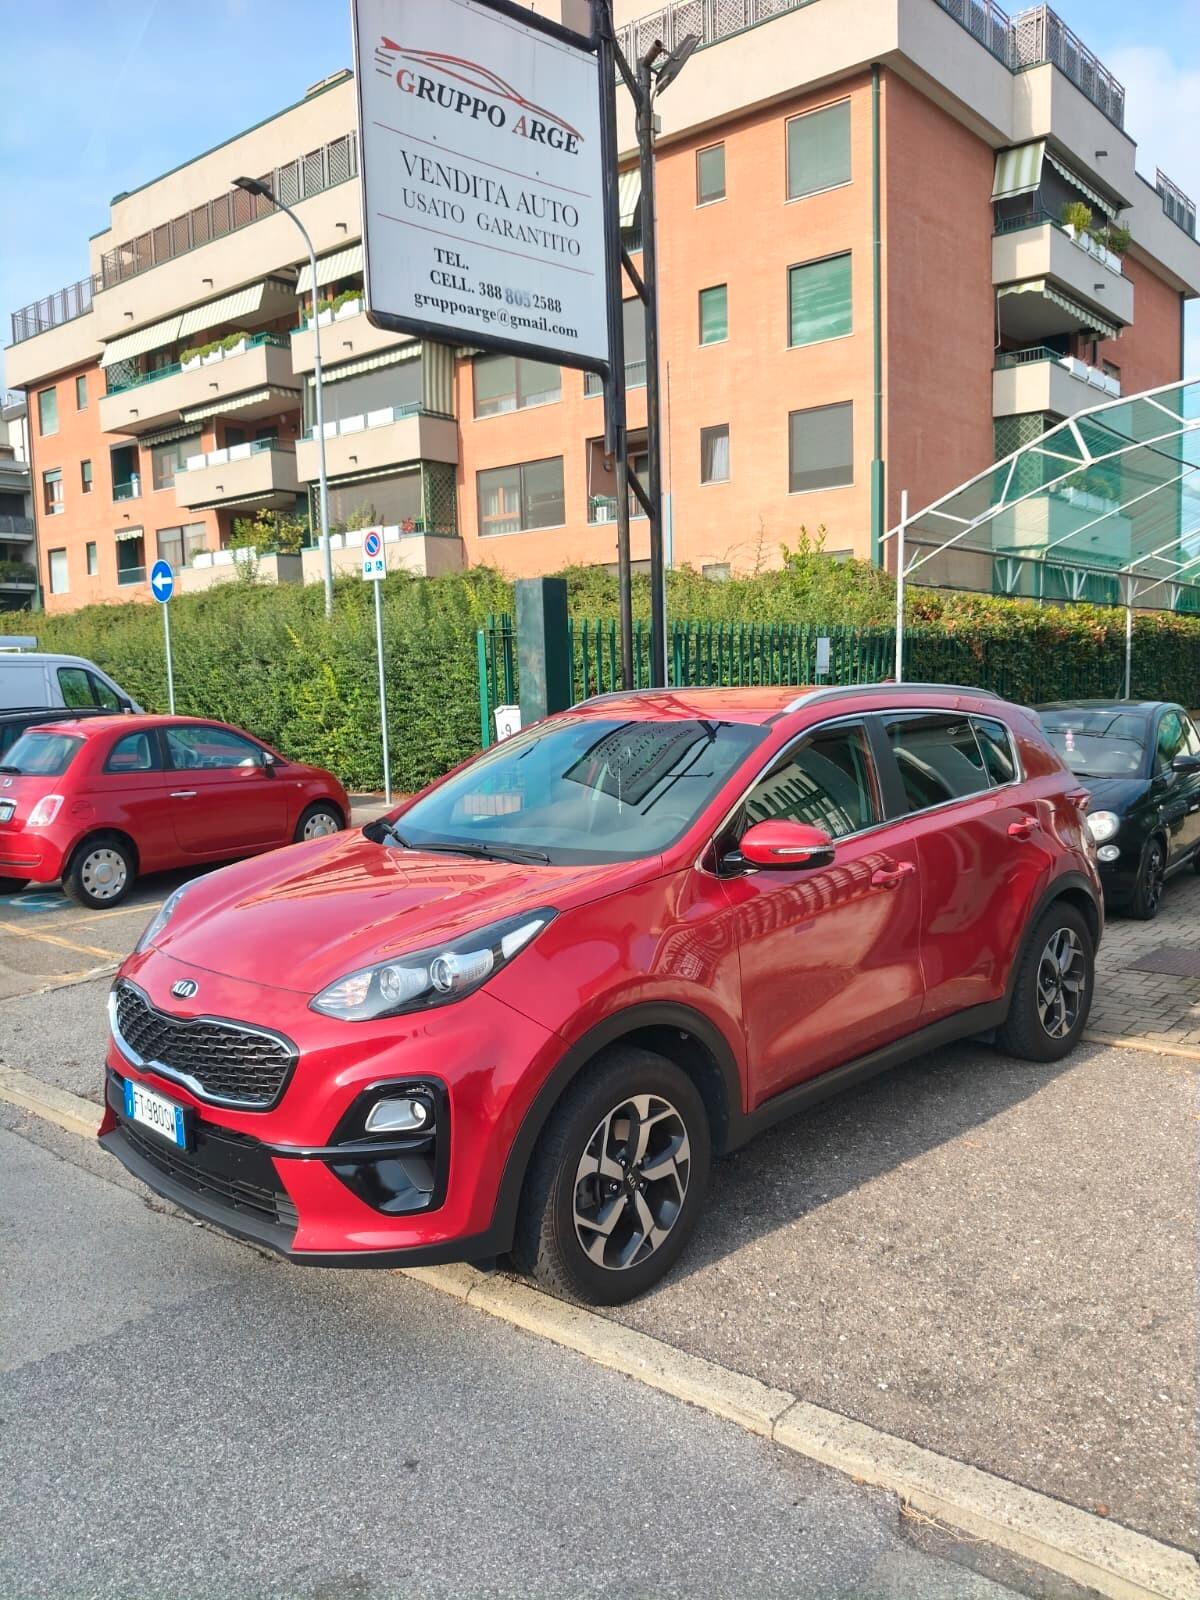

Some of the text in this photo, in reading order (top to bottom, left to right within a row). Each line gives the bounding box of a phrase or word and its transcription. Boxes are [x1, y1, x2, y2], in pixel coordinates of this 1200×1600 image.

[396, 69, 579, 155] GRUPPO ARGE
[400, 149, 579, 228] VENDITA AUTO
[402, 187, 581, 257] USATO GARANTITO
[434, 247, 469, 270] TEL.
[414, 292, 578, 338] gruppoarge@gmail.com
[430, 269, 475, 294] CELL.
[478, 282, 502, 300] 388
[532, 294, 562, 314] 2588
